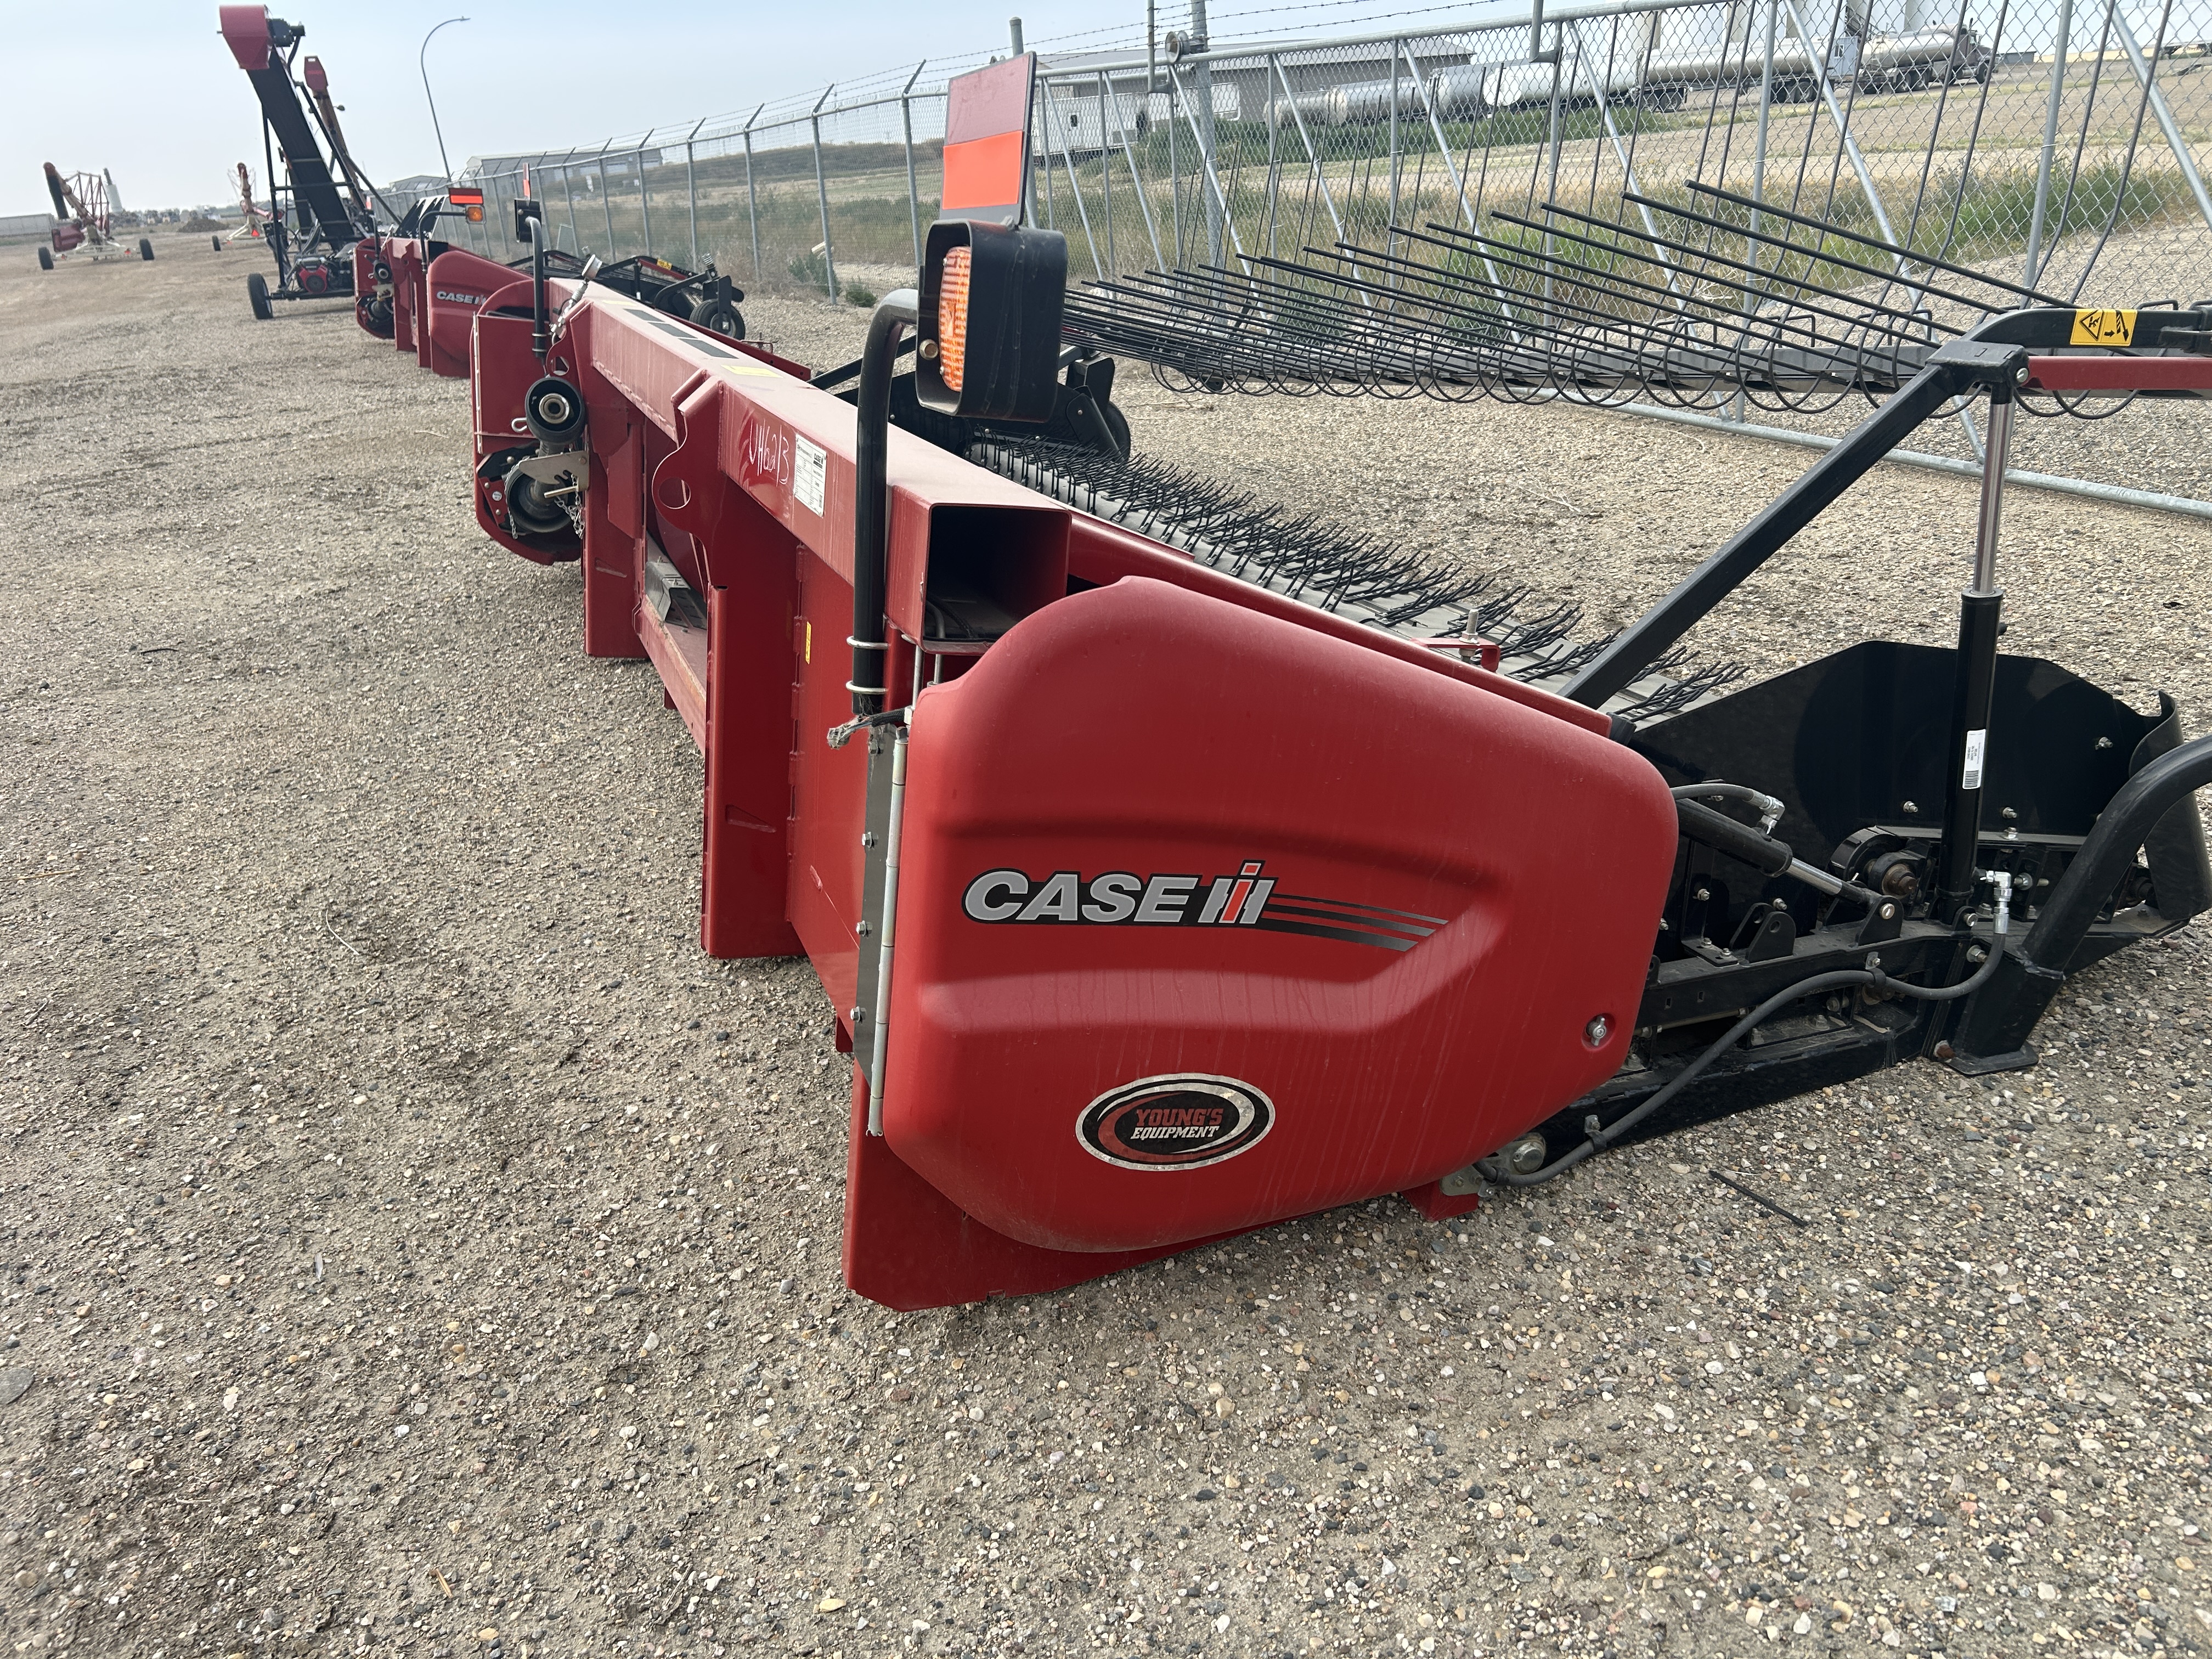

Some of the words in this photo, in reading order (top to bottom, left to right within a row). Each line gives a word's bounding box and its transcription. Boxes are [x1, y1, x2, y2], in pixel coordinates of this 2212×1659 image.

[437, 291, 473, 304] CASE
[965, 871, 1199, 923] CASE
[1136, 1108, 1223, 1126] YOUNG'S
[1130, 1126, 1220, 1141] EQUIPMENT
